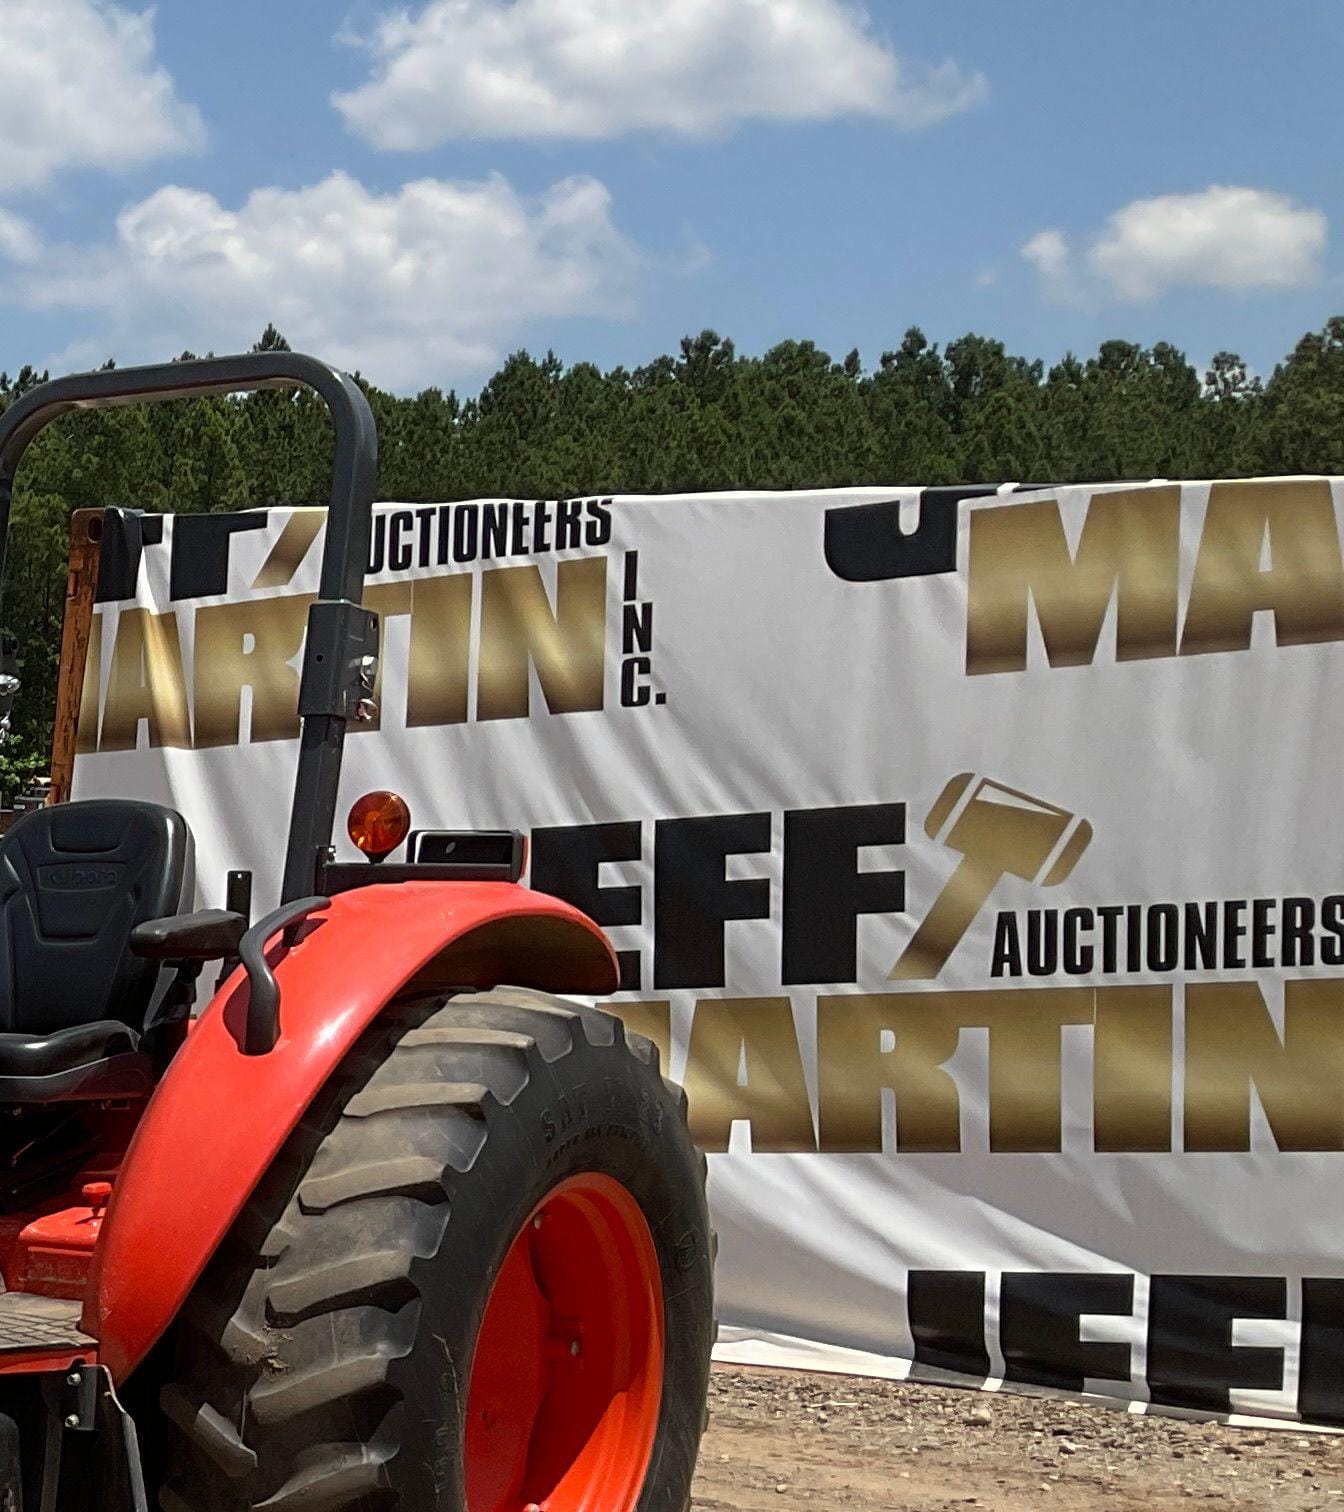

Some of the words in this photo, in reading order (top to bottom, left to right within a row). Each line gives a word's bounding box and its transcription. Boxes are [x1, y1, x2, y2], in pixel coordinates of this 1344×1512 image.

[364, 499, 613, 575] UCTIONEERS
[530, 802, 907, 991] EFF
[990, 894, 1344, 978] AUCTIONEERS
